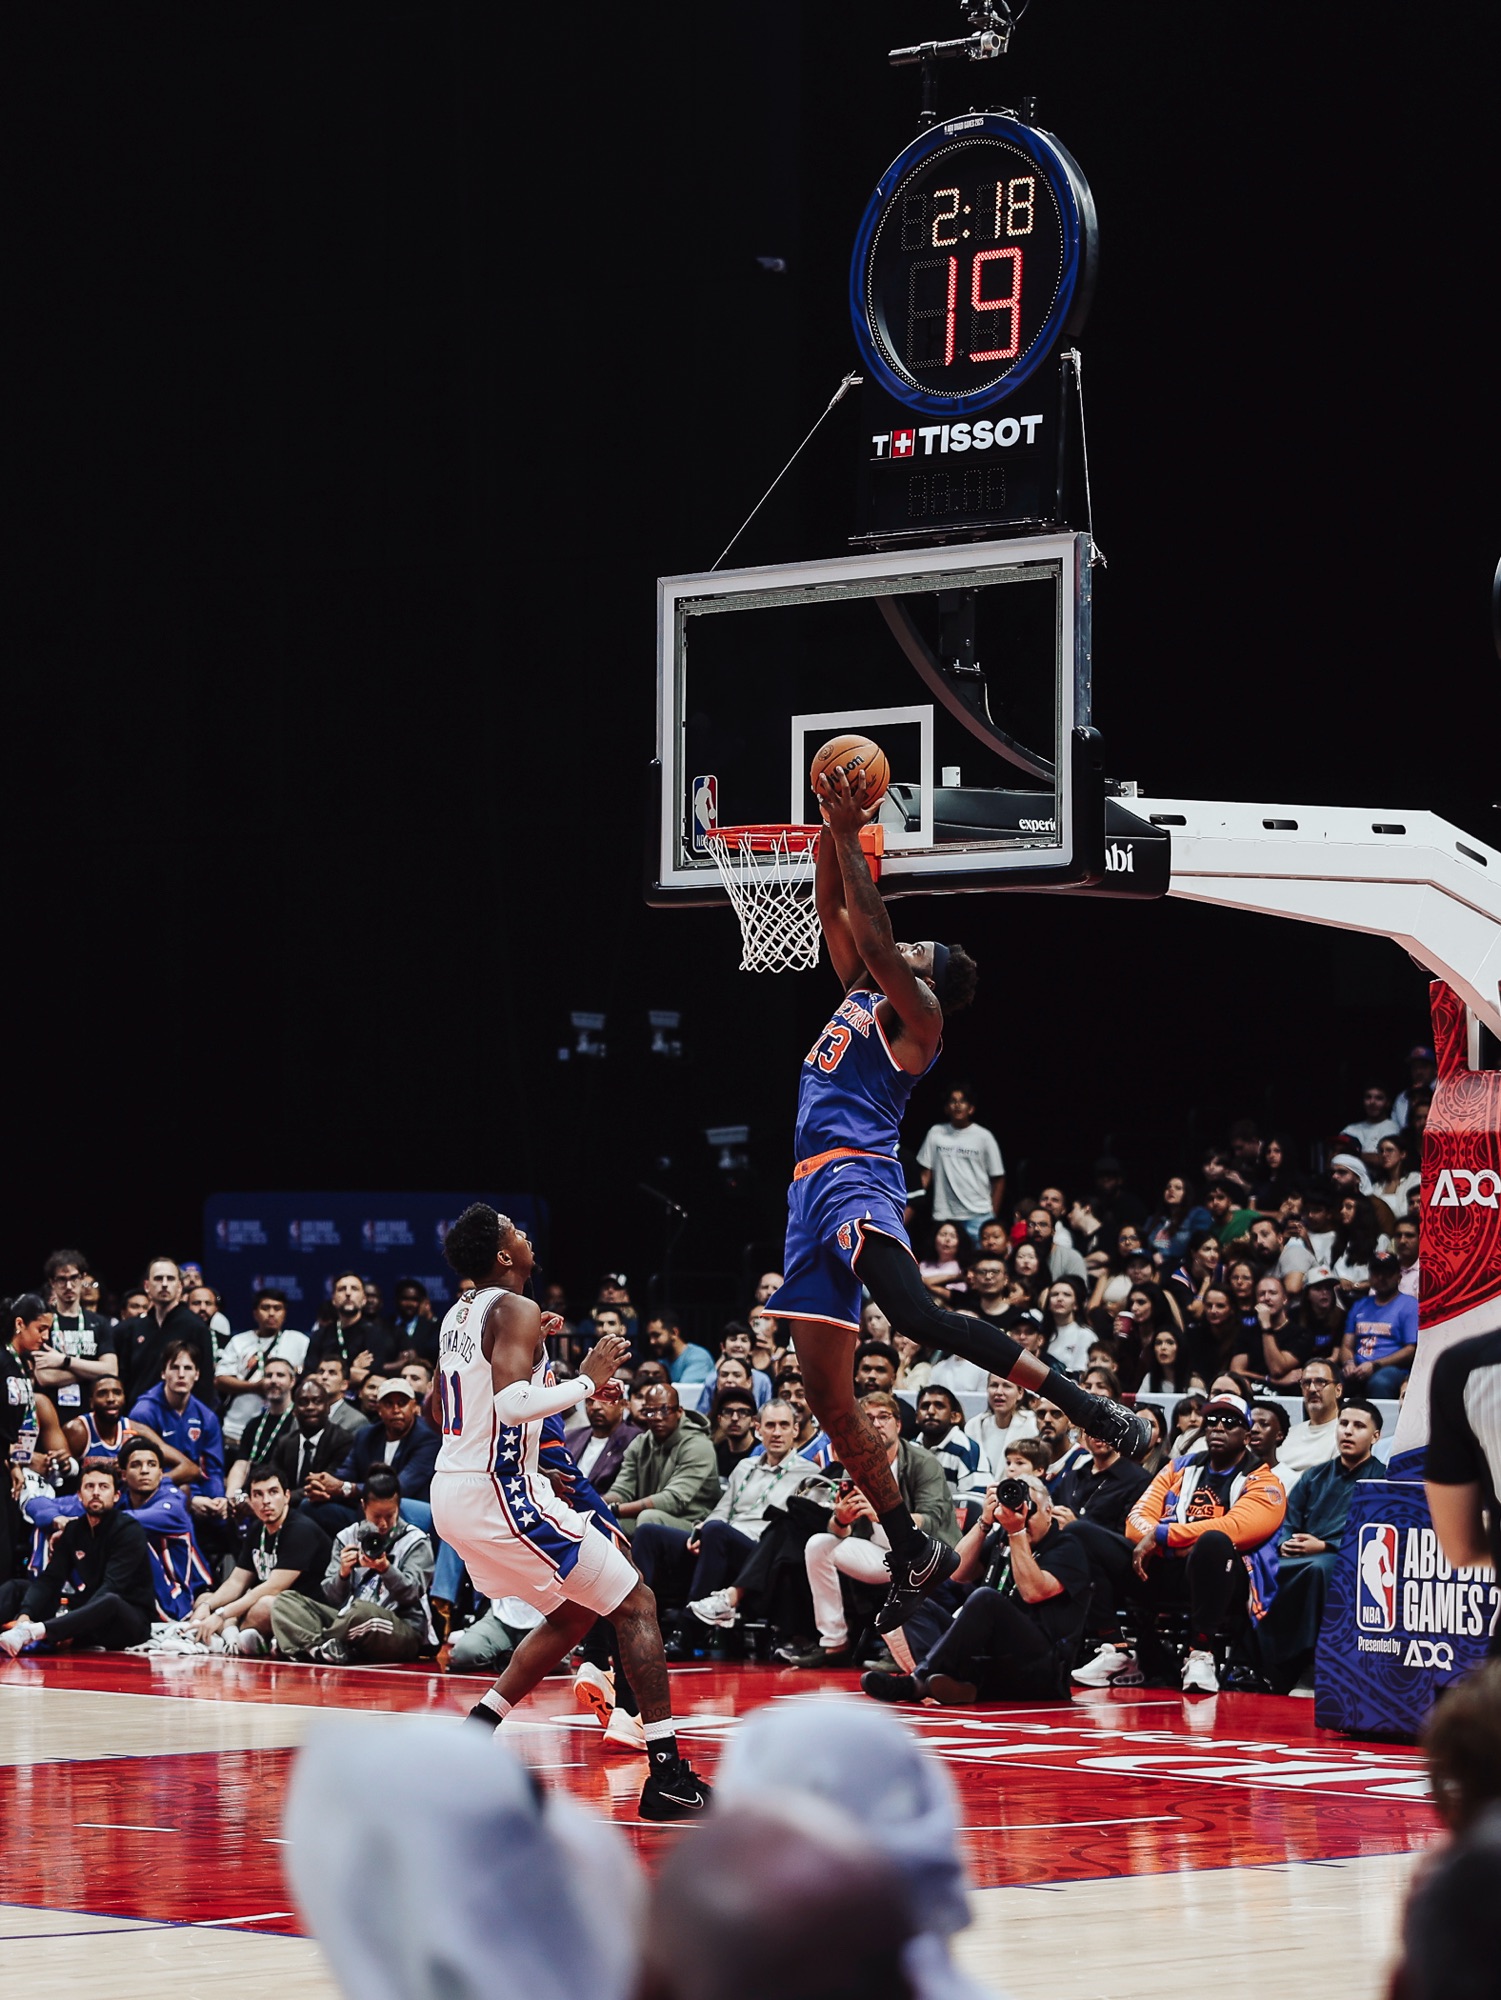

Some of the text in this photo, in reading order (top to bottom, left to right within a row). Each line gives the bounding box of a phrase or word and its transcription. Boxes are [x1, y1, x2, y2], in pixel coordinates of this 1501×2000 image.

[931, 175, 1036, 248] 2:18
[944, 246, 1024, 367] 19
[918, 414, 1044, 455] TISSOT
[1430, 1168, 1501, 1209] ADQ
[1362, 1606, 1381, 1625] NBA
[1403, 1580, 1484, 1637] GAMES
[1357, 1635, 1401, 1656] Presented by
[1403, 1639, 1454, 1671] ADQ
